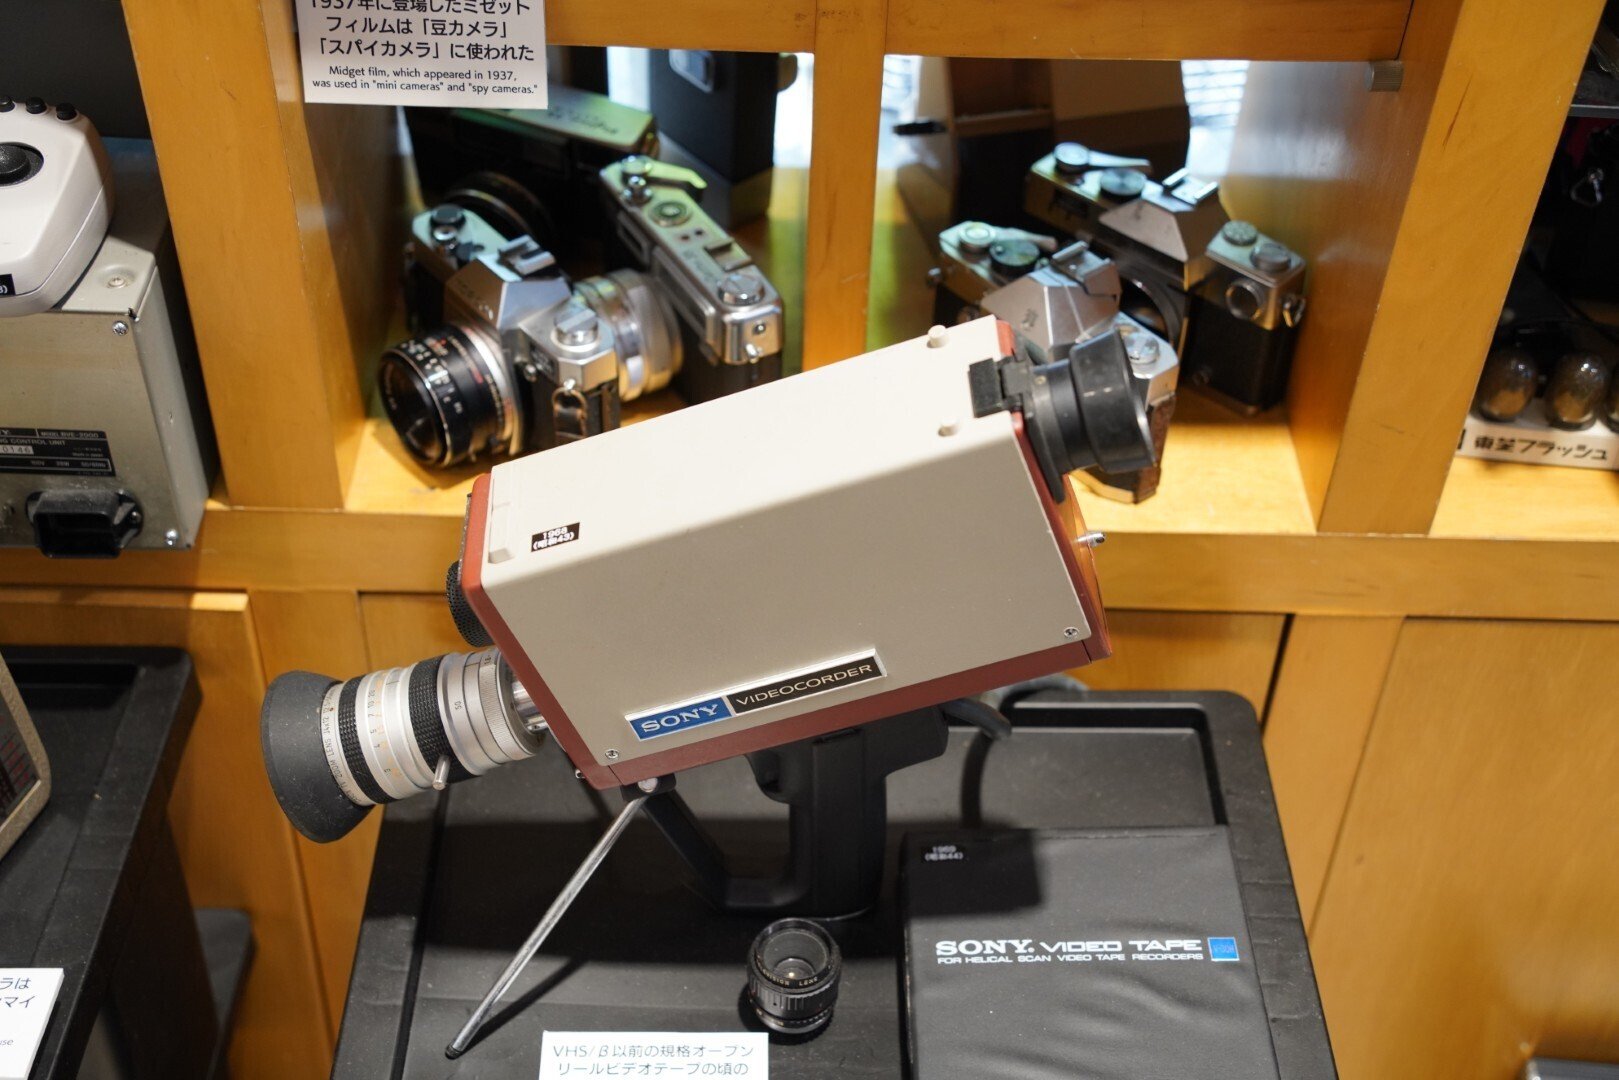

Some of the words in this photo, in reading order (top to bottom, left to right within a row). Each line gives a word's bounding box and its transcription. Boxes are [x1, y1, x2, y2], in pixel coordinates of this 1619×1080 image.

[326, 16, 508, 38] フィルムは「豆カメラ」
[319, 37, 535, 61] 「スパイカメラ」に使われた
[329, 65, 365, 77] Midget
[368, 66, 390, 77] film,
[392, 67, 421, 77] which
[423, 69, 471, 80] appeared
[475, 70, 483, 80] in
[487, 71, 517, 81] 1937,
[312, 80, 331, 88] was
[334, 79, 358, 89] used
[361, 79, 370, 89] in
[372, 80, 397, 90] "mini
[400, 82, 444, 92] cameras"
[447, 82, 466, 92] and
[468, 83, 489, 95] "spy
[492, 85, 537, 94] cameras."
[454, 700, 463, 710] 50
[641, 704, 719, 734] SONY
[735, 663, 873, 706] VIDEOCORDER
[323, 738, 335, 757] LENS
[329, 759, 343, 778] ZOOM
[1039, 941, 1122, 952] VIDEO
[1128, 939, 1203, 952] TAPE
[965, 955, 1013, 964] HELICAL
[1017, 955, 1052, 963] SCAN
[1056, 954, 1093, 962] VIDEO
[1095, 954, 1126, 962] TAPE
[1132, 953, 1204, 961] RECORDERS
[558, 1063, 749, 1076] リールビデオテープの頃の
